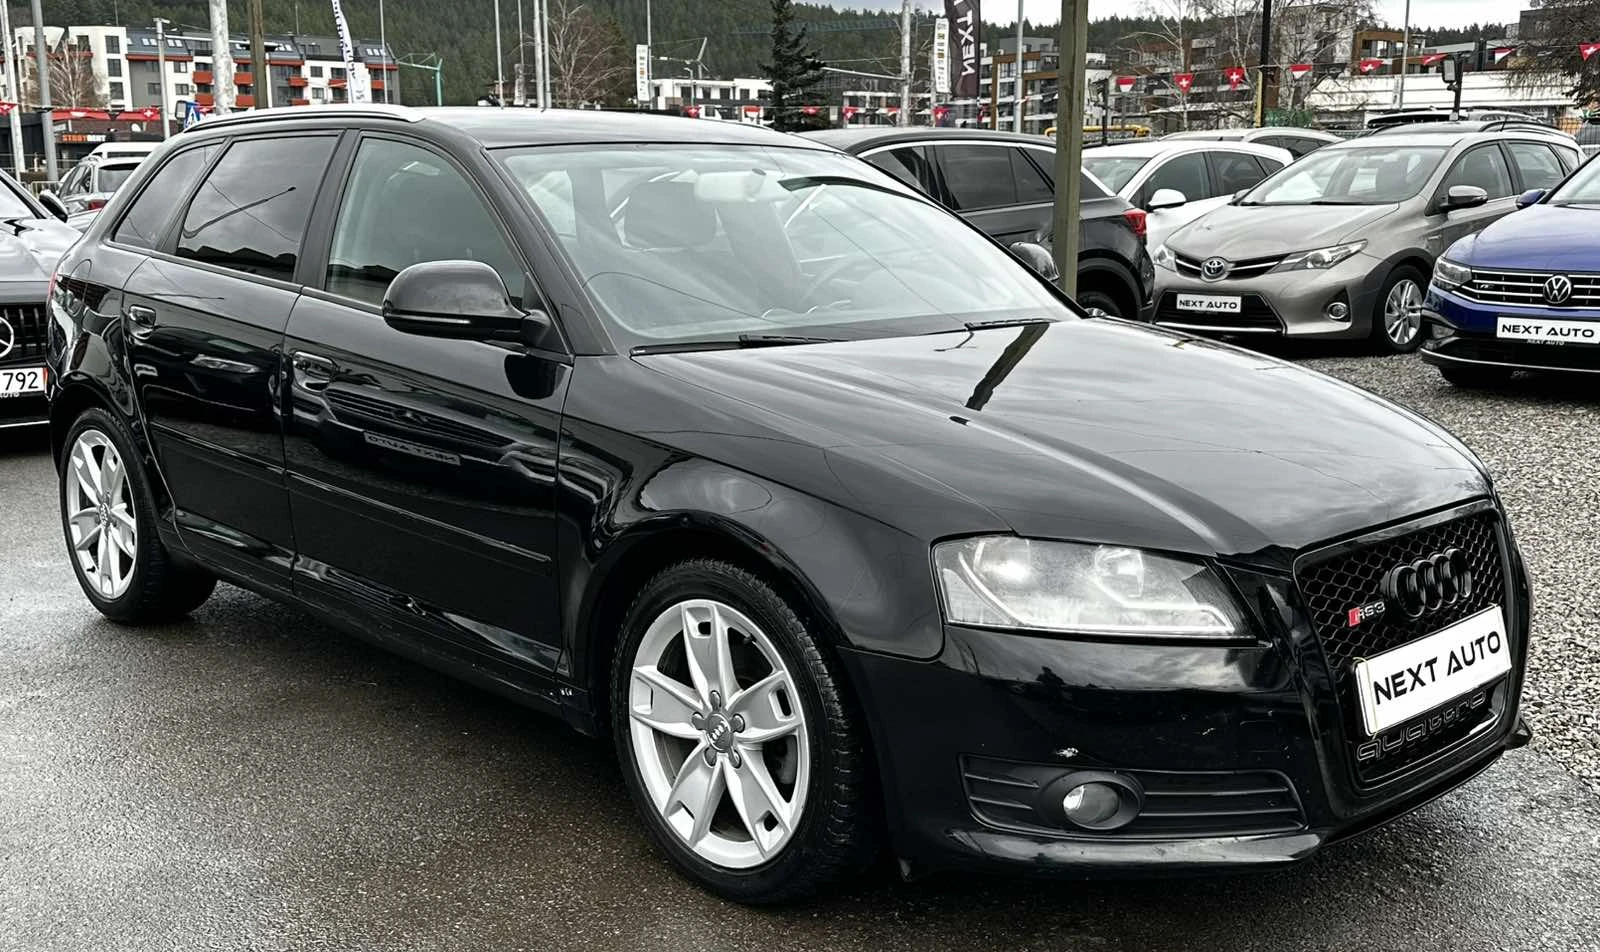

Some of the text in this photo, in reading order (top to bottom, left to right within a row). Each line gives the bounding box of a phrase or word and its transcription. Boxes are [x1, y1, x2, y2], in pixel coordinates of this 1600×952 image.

[1179, 299, 1238, 310] NEXT AUTO
[1502, 324, 1595, 338] NEXT AUTO
[2, 371, 39, 391] 792
[1351, 601, 1386, 623] RS3
[1373, 631, 1501, 705] NEXT AUTO
